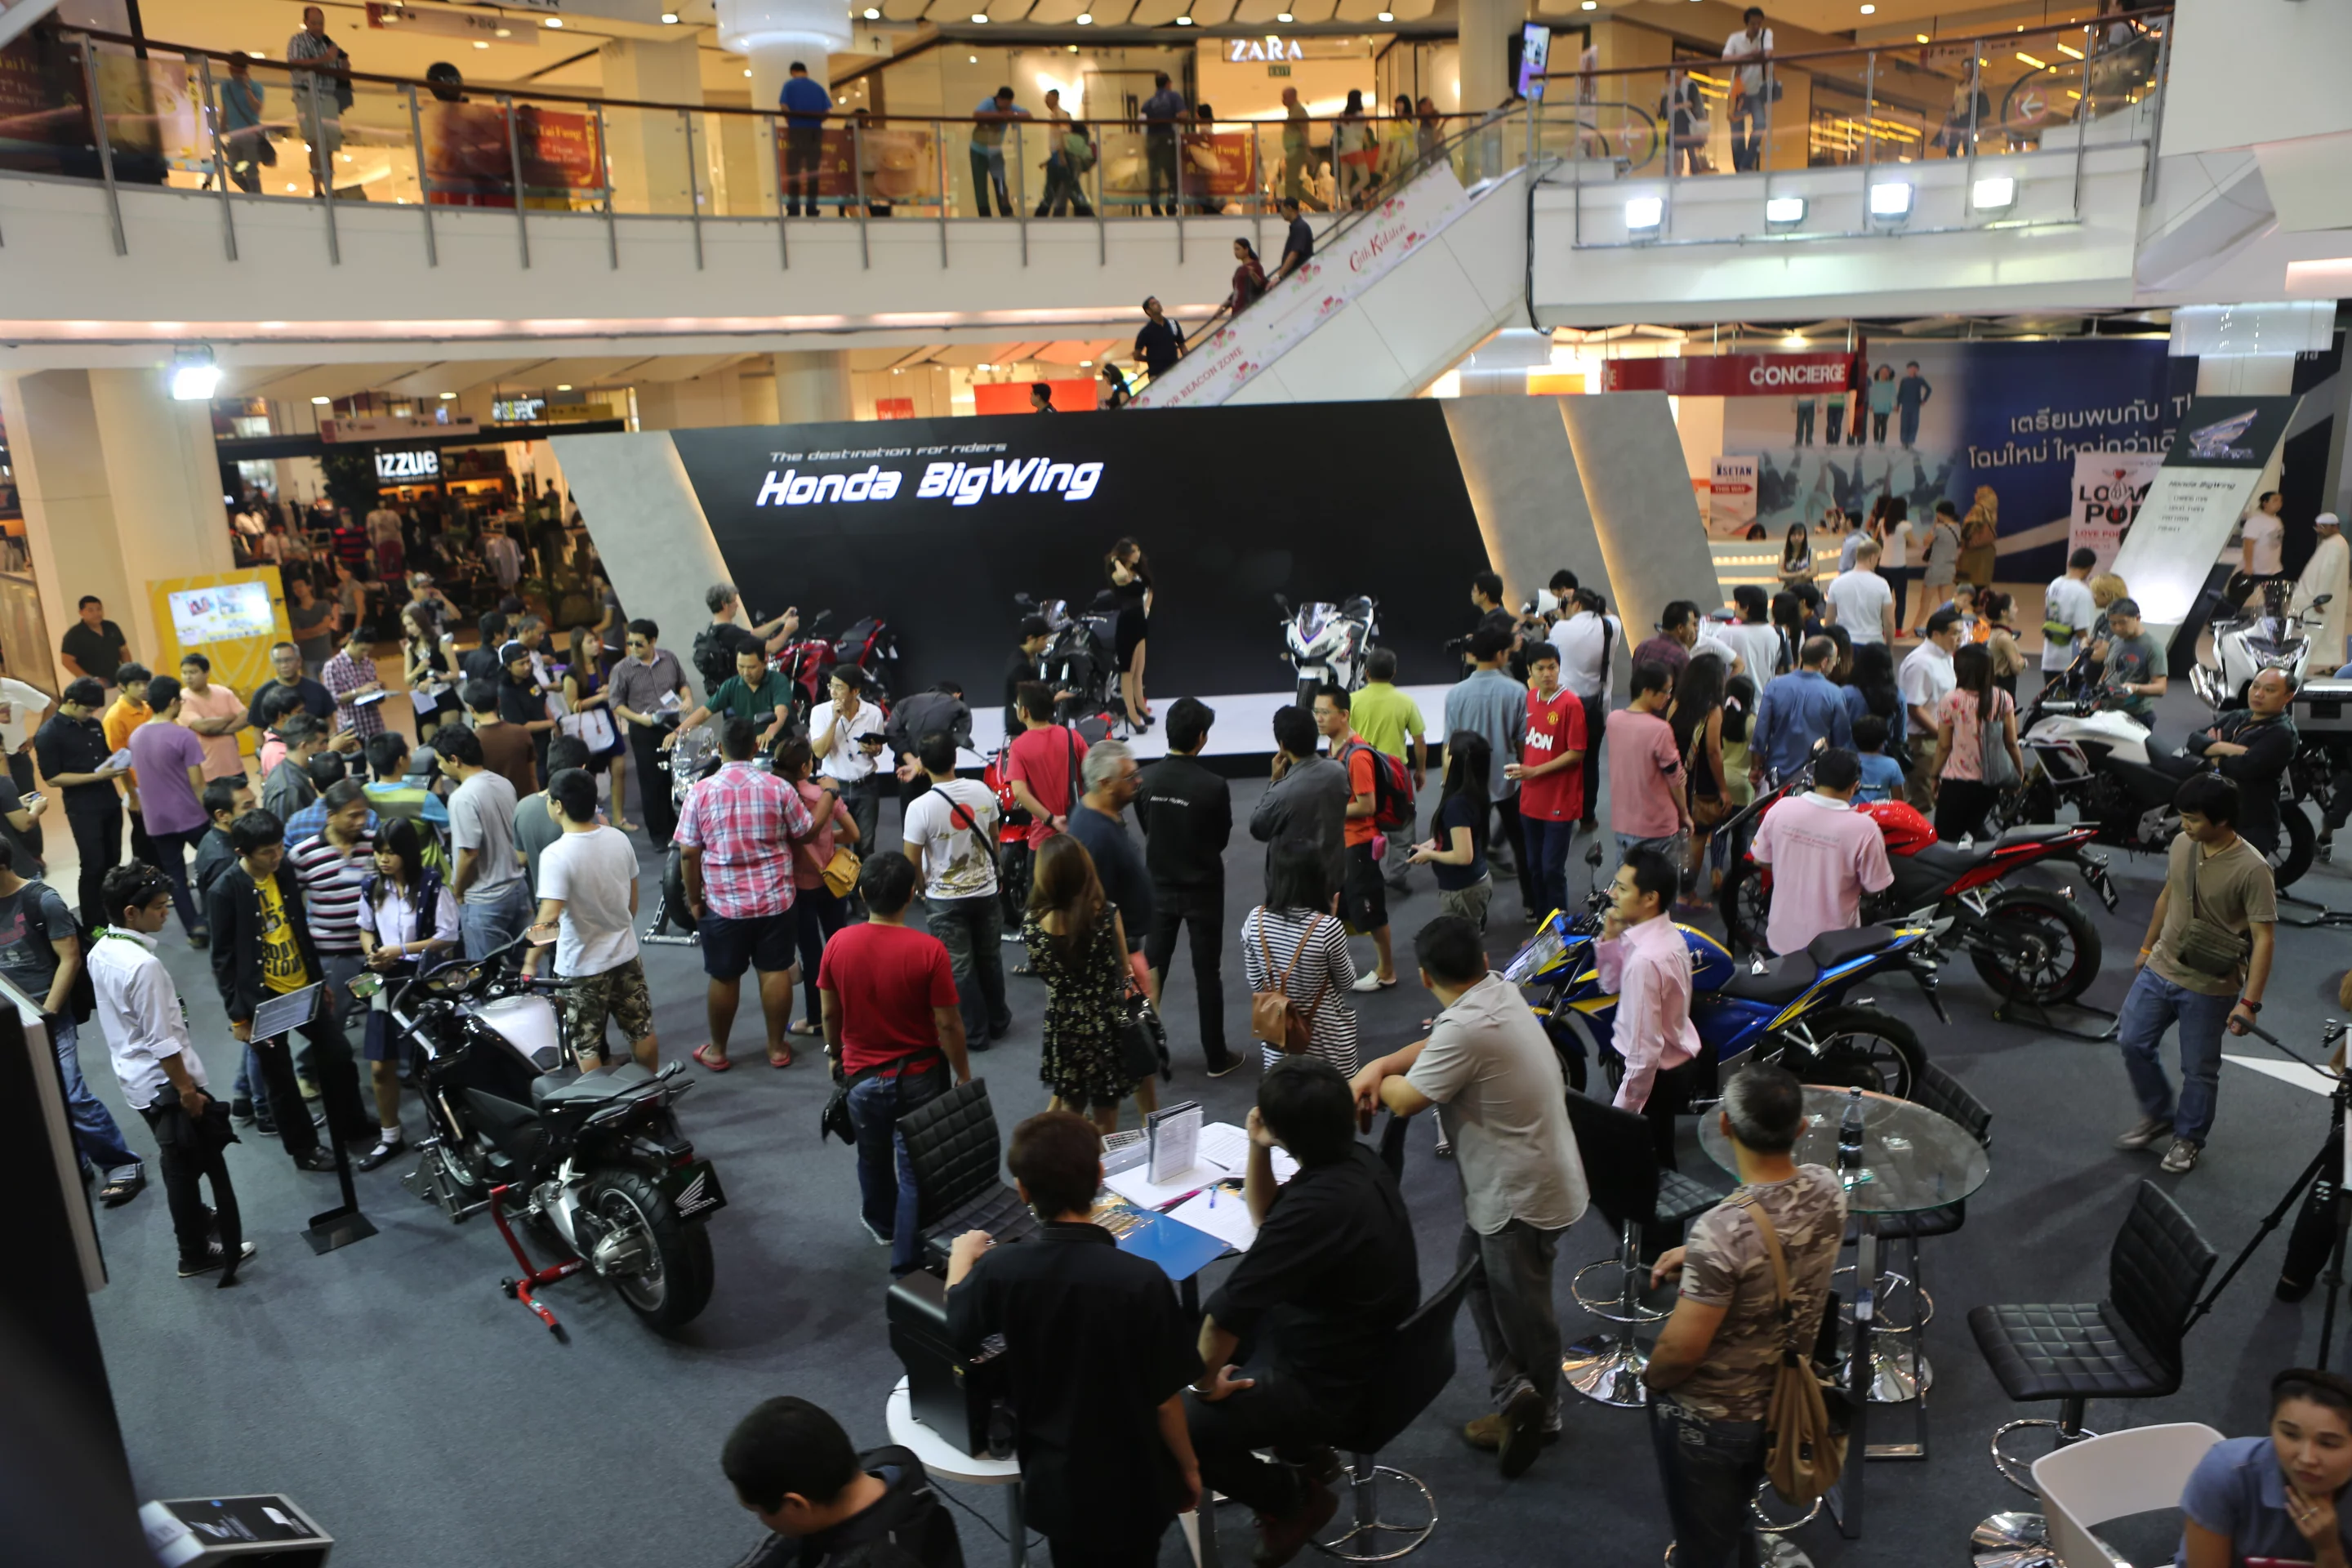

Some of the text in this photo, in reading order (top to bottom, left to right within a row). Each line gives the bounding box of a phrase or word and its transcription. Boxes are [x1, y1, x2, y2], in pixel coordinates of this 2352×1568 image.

[1230, 38, 1304, 62] ZARA
[1180, 365, 1218, 399] BEACON
[1217, 346, 1244, 371] ZONE
[1749, 363, 1846, 385] CONCIERGE
[374, 447, 439, 478] izzue
[770, 443, 1007, 462] The destination for riders
[756, 457, 1104, 506] Honda BigWing
[2075, 529, 2099, 537] LOVE
[1526, 726, 1554, 751] AON
